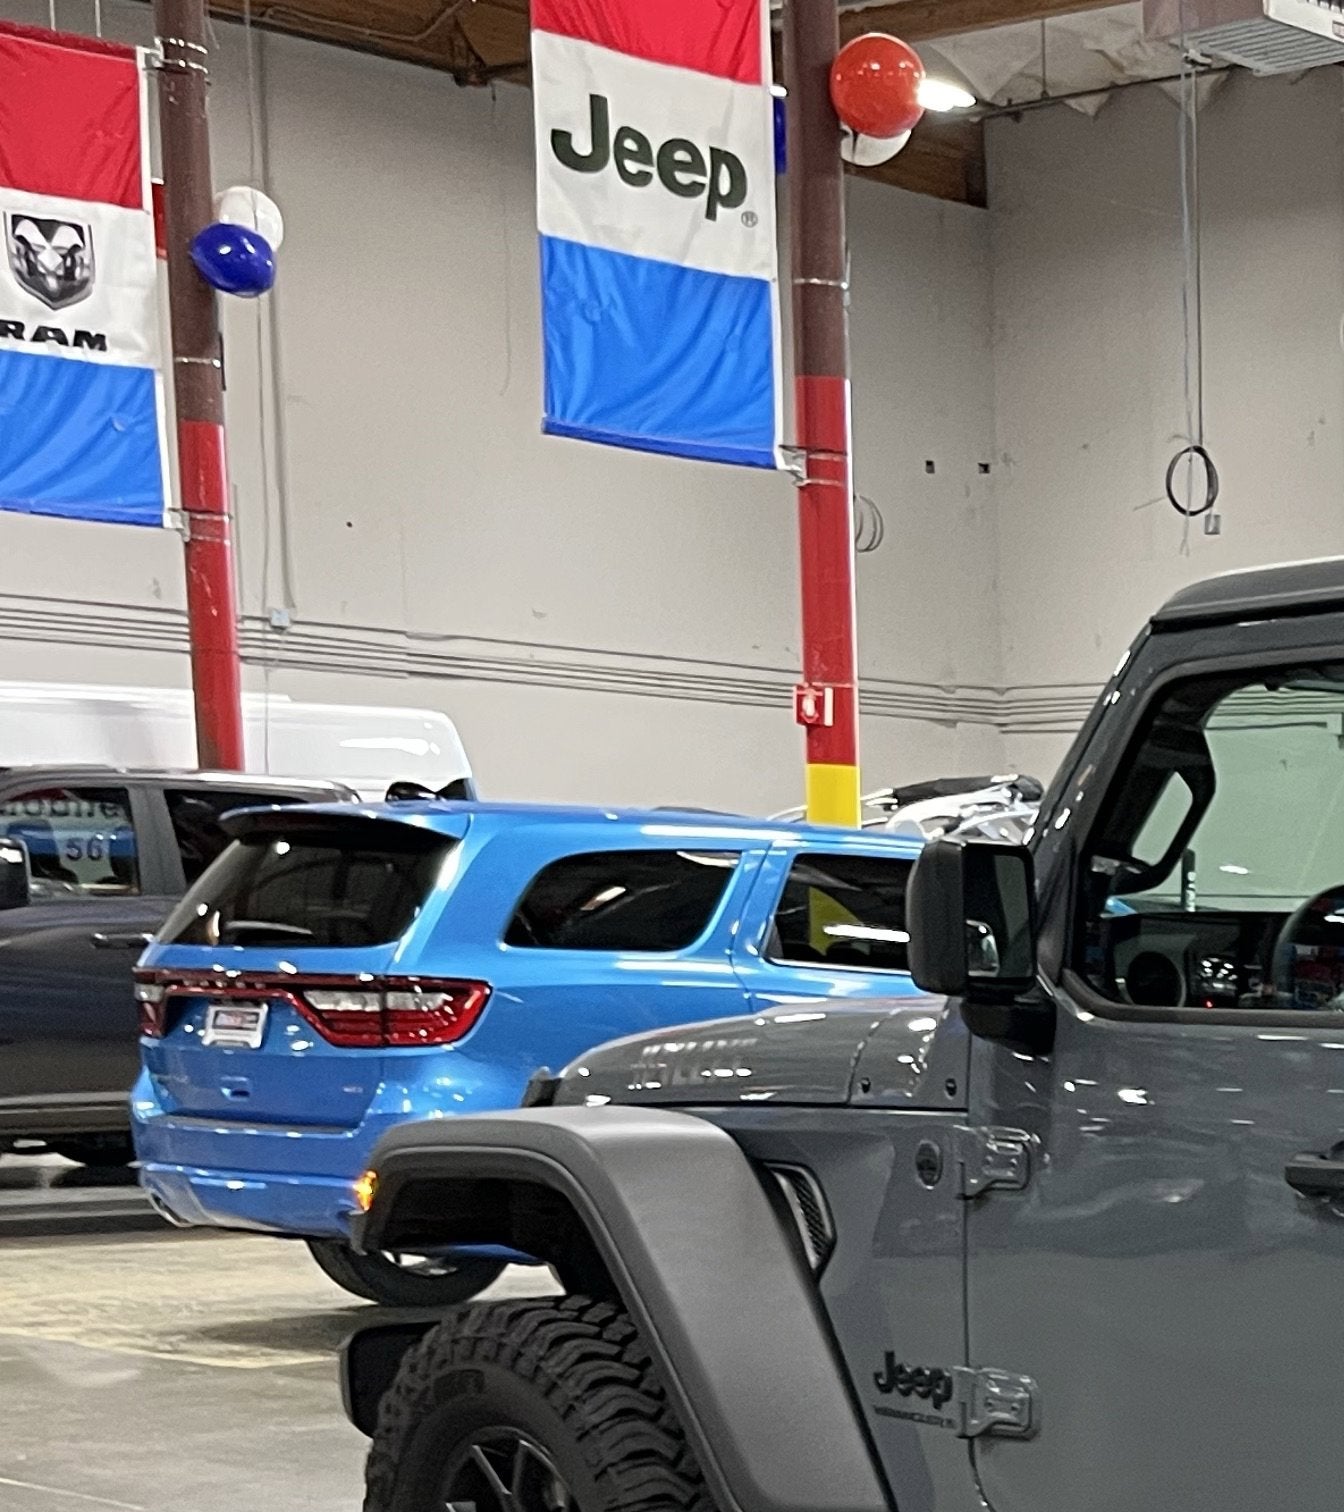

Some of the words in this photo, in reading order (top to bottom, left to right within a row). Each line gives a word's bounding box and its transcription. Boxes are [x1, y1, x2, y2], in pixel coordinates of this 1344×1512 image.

[551, 93, 748, 222] Jeep
[0, 319, 107, 352] RAM
[873, 1350, 953, 1411] Jeep
